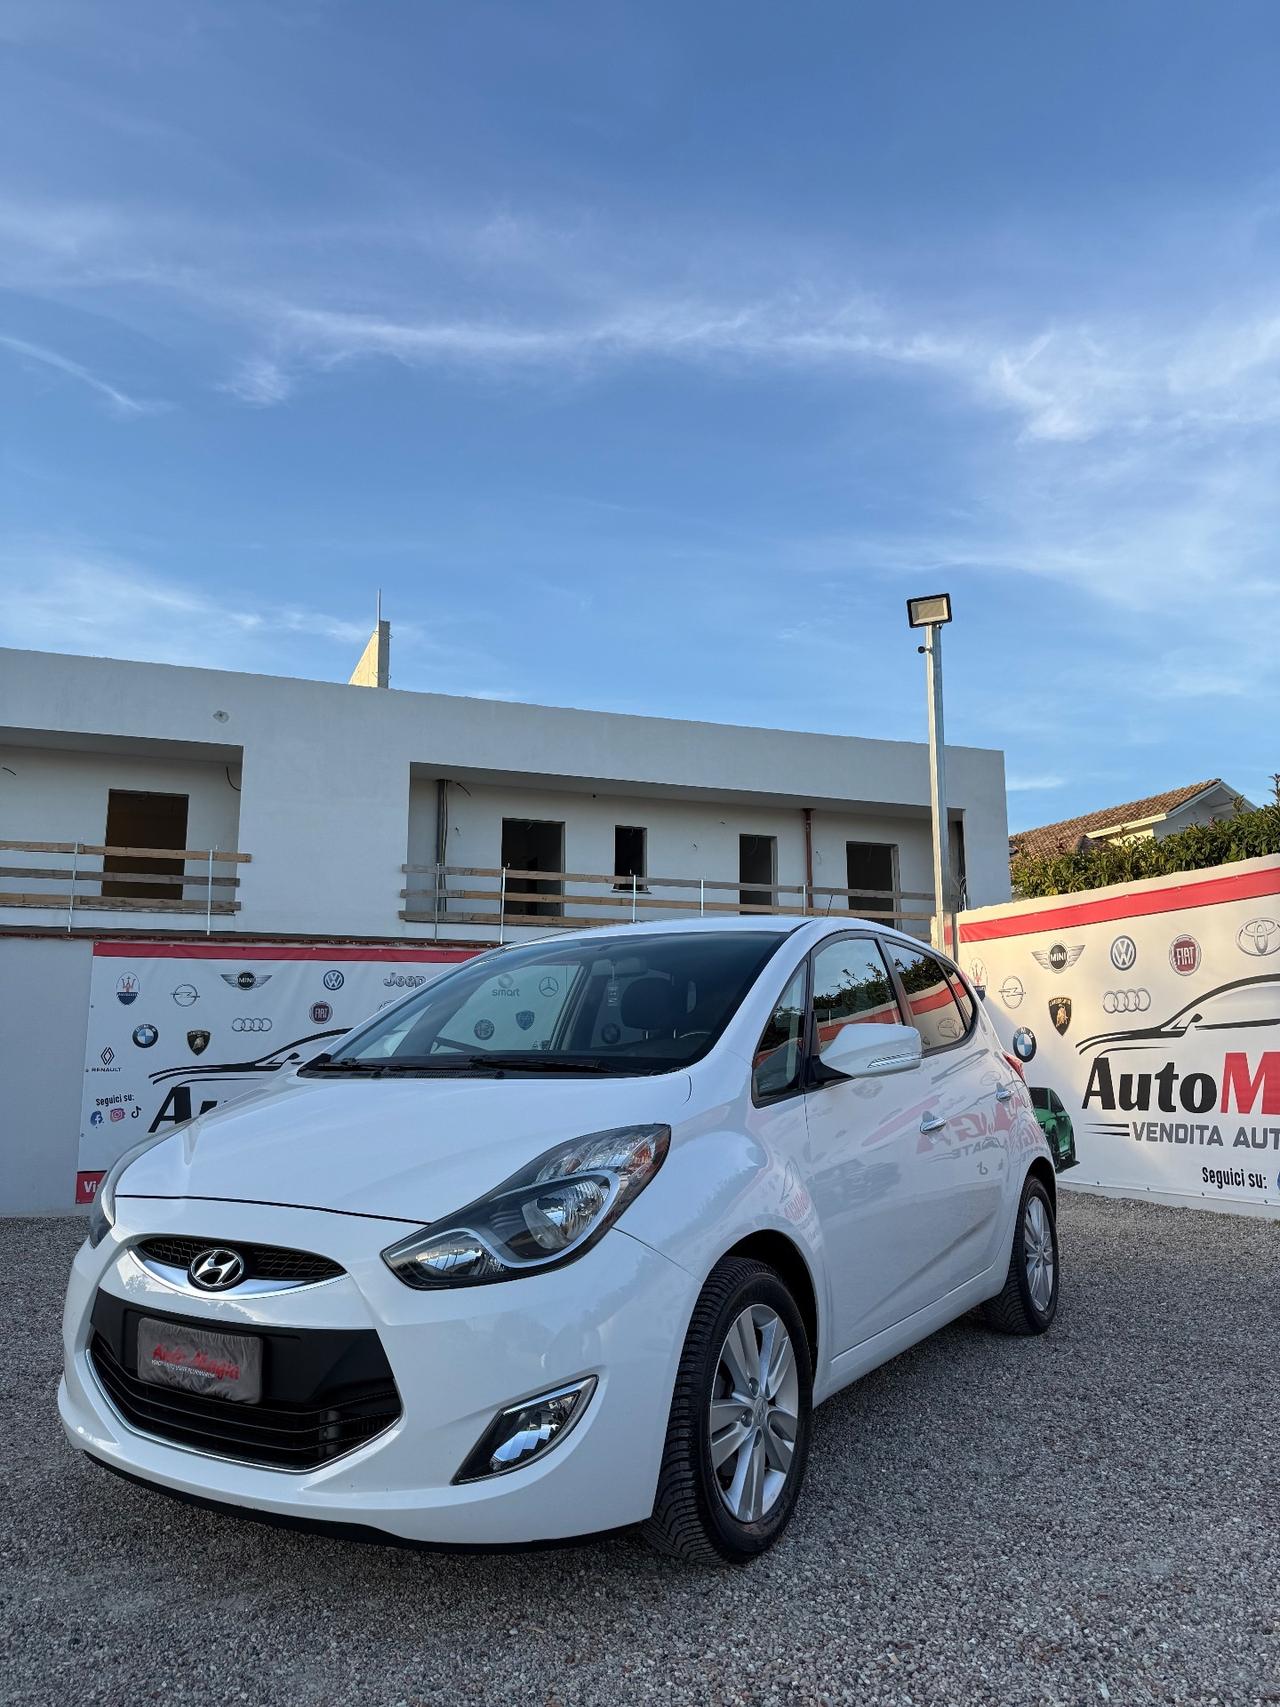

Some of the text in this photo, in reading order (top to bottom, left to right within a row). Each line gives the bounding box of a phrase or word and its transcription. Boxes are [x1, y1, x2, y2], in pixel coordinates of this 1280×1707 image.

[1050, 952, 1067, 962] MINI
[1176, 946, 1194, 965] FIAT
[492, 988, 520, 996] smart
[315, 1007, 329, 1019] FIAT
[95, 1093, 135, 1107] Seguici su:
[1132, 1122, 1280, 1150] VENDITA AUT
[1201, 1166, 1268, 1189] Seguici su:
